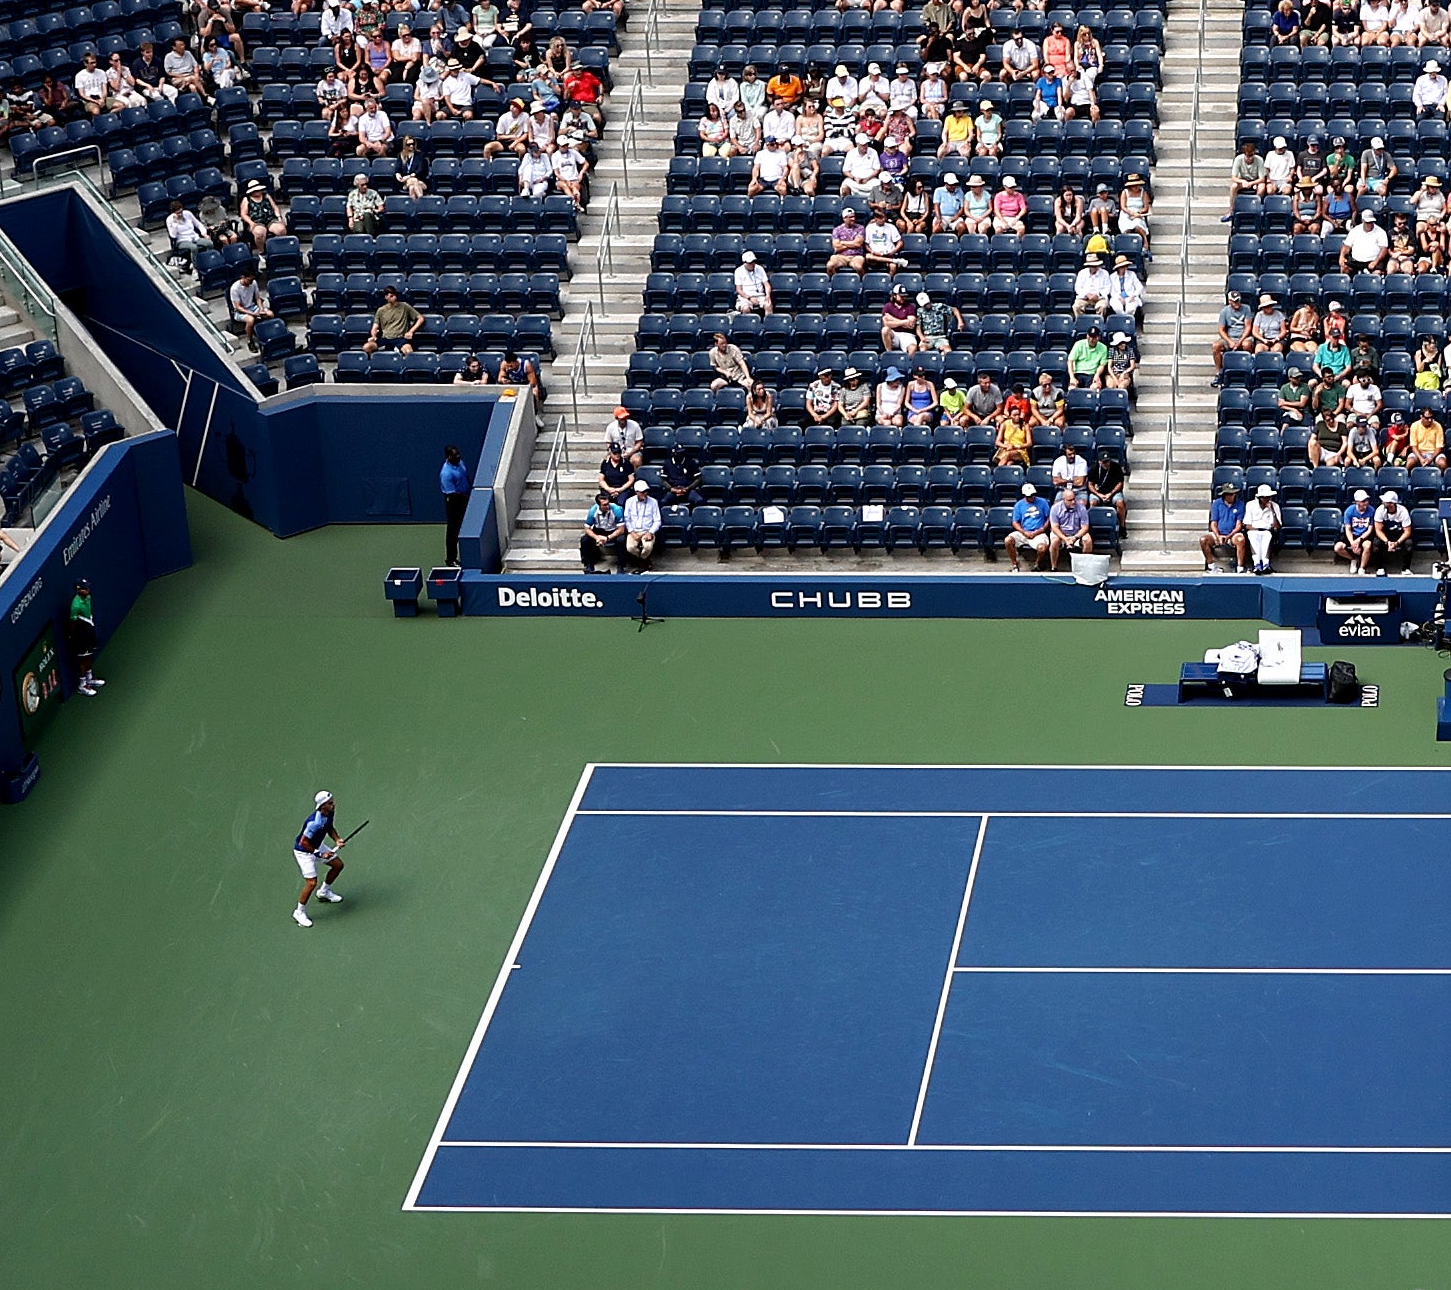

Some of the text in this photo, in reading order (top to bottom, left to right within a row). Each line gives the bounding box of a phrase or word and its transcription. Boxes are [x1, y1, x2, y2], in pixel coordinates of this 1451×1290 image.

[497, 587, 604, 608] Deloitte.
[770, 591, 912, 608] CHUBB
[1094, 590, 1184, 603] AMERICAN
[1107, 603, 1185, 615] EXPRESS
[1338, 622, 1381, 637] evian
[1125, 684, 1145, 706] POLO
[1361, 685, 1379, 707] POLO
